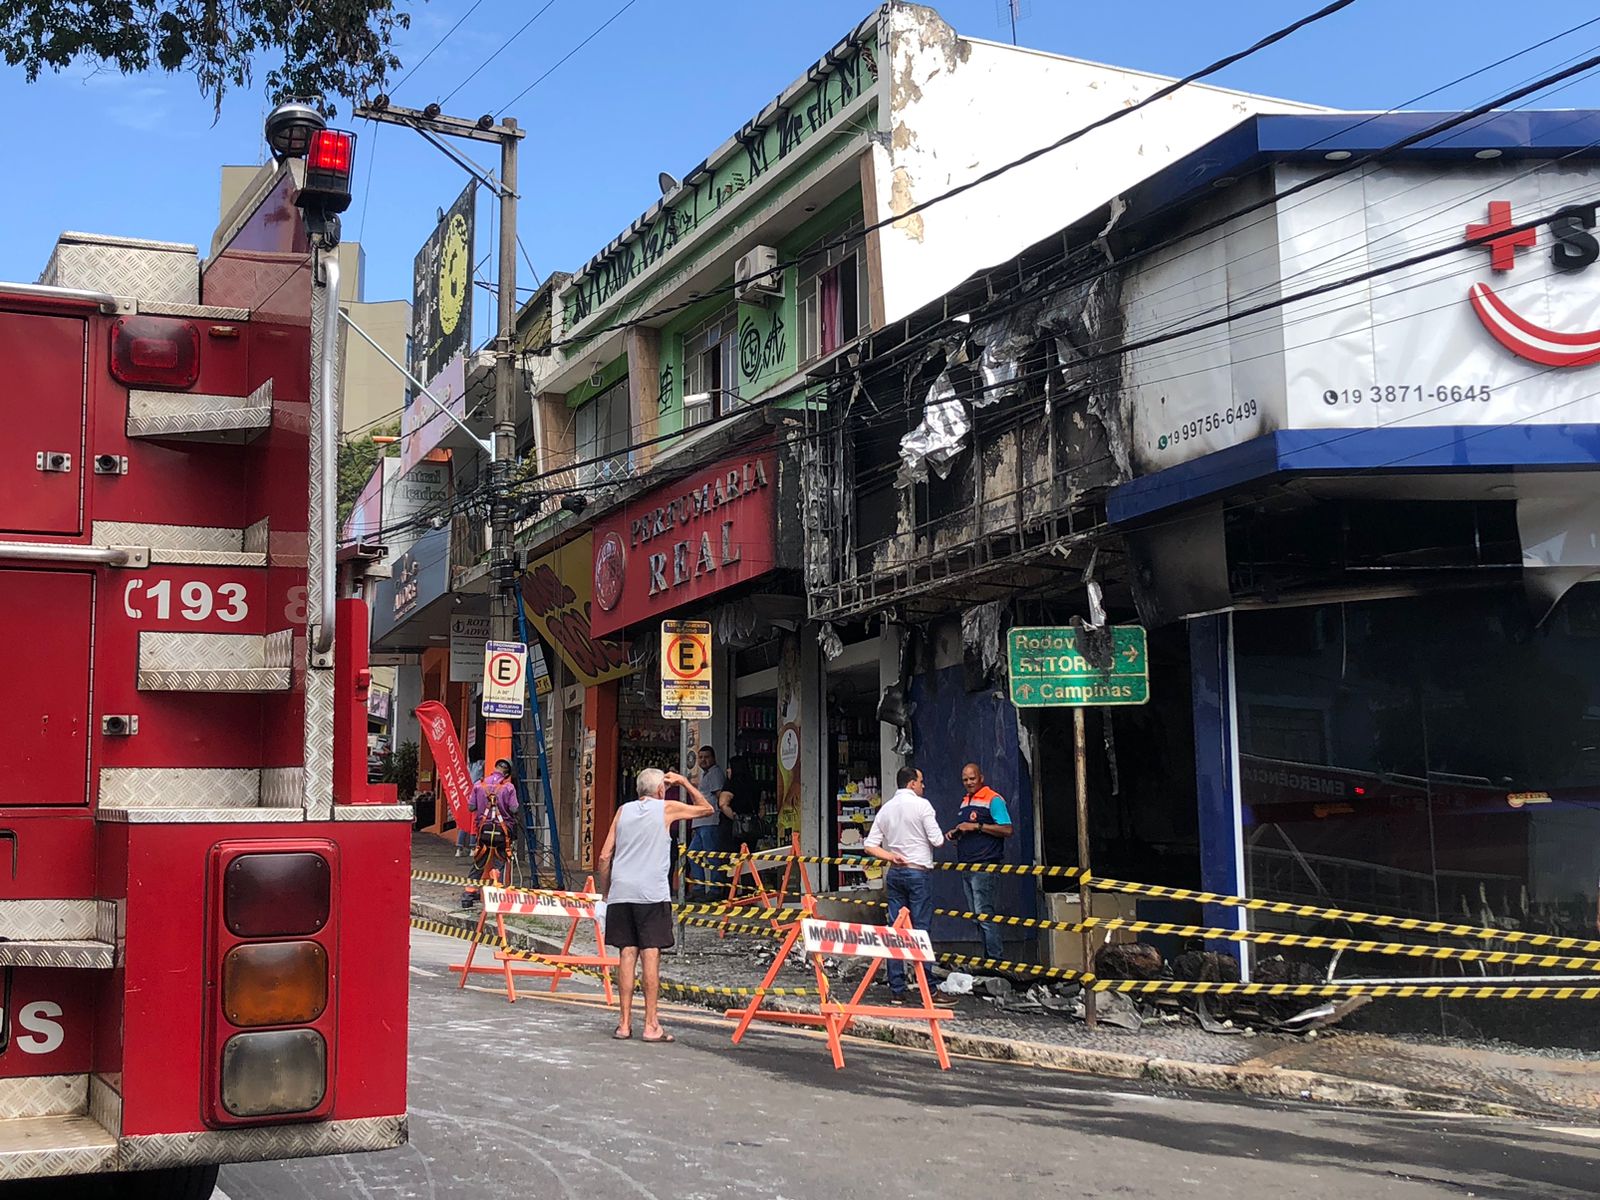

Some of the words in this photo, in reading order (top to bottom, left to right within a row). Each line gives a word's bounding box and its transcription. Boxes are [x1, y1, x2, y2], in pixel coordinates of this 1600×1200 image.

[1341, 389, 1362, 404] 19
[1369, 385, 1492, 403] 3871-6645
[1167, 430, 1180, 445] 19
[1181, 399, 1258, 441] 99756-6499
[630, 457, 769, 549] PERFUMARIA
[647, 519, 742, 598] REAL
[146, 579, 249, 622] 193
[464, 627, 490, 637] ADVO
[1015, 634, 1076, 650] Rodov
[498, 659, 511, 680] E
[679, 643, 695, 670] E
[1020, 655, 1115, 673] RETOR
[1040, 682, 1133, 702] Campinas
[446, 735, 471, 801] METICOS
[444, 765, 461, 811] REAL
[488, 891, 558, 907] MOBILIDADE
[808, 925, 881, 947] MOBILIDADE
[881, 932, 928, 950] URBANA
[0, 1001, 64, 1054] S
